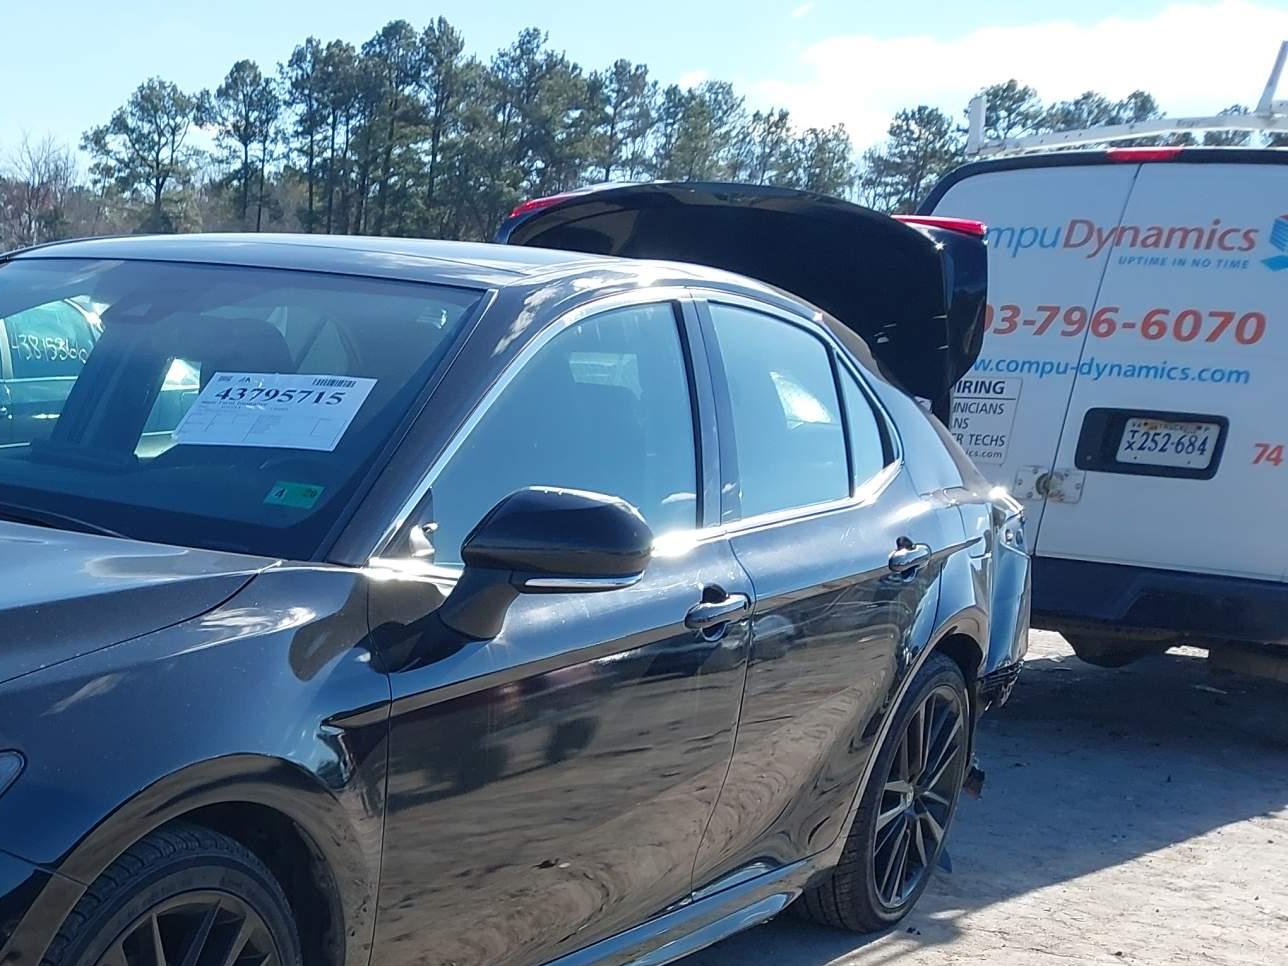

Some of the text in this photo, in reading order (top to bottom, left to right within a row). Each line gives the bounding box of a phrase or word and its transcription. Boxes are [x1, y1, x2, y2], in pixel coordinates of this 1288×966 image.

[986, 218, 1260, 259] mpuDynamics
[1118, 255, 1250, 270] UPTIME IN NO TIME
[973, 356, 1251, 385] w.compu-dynamics.com
[214, 387, 347, 406] 43795715
[954, 380, 1005, 395] IRING
[968, 433, 1006, 447] TECHS
[1251, 442, 1285, 467] 74
